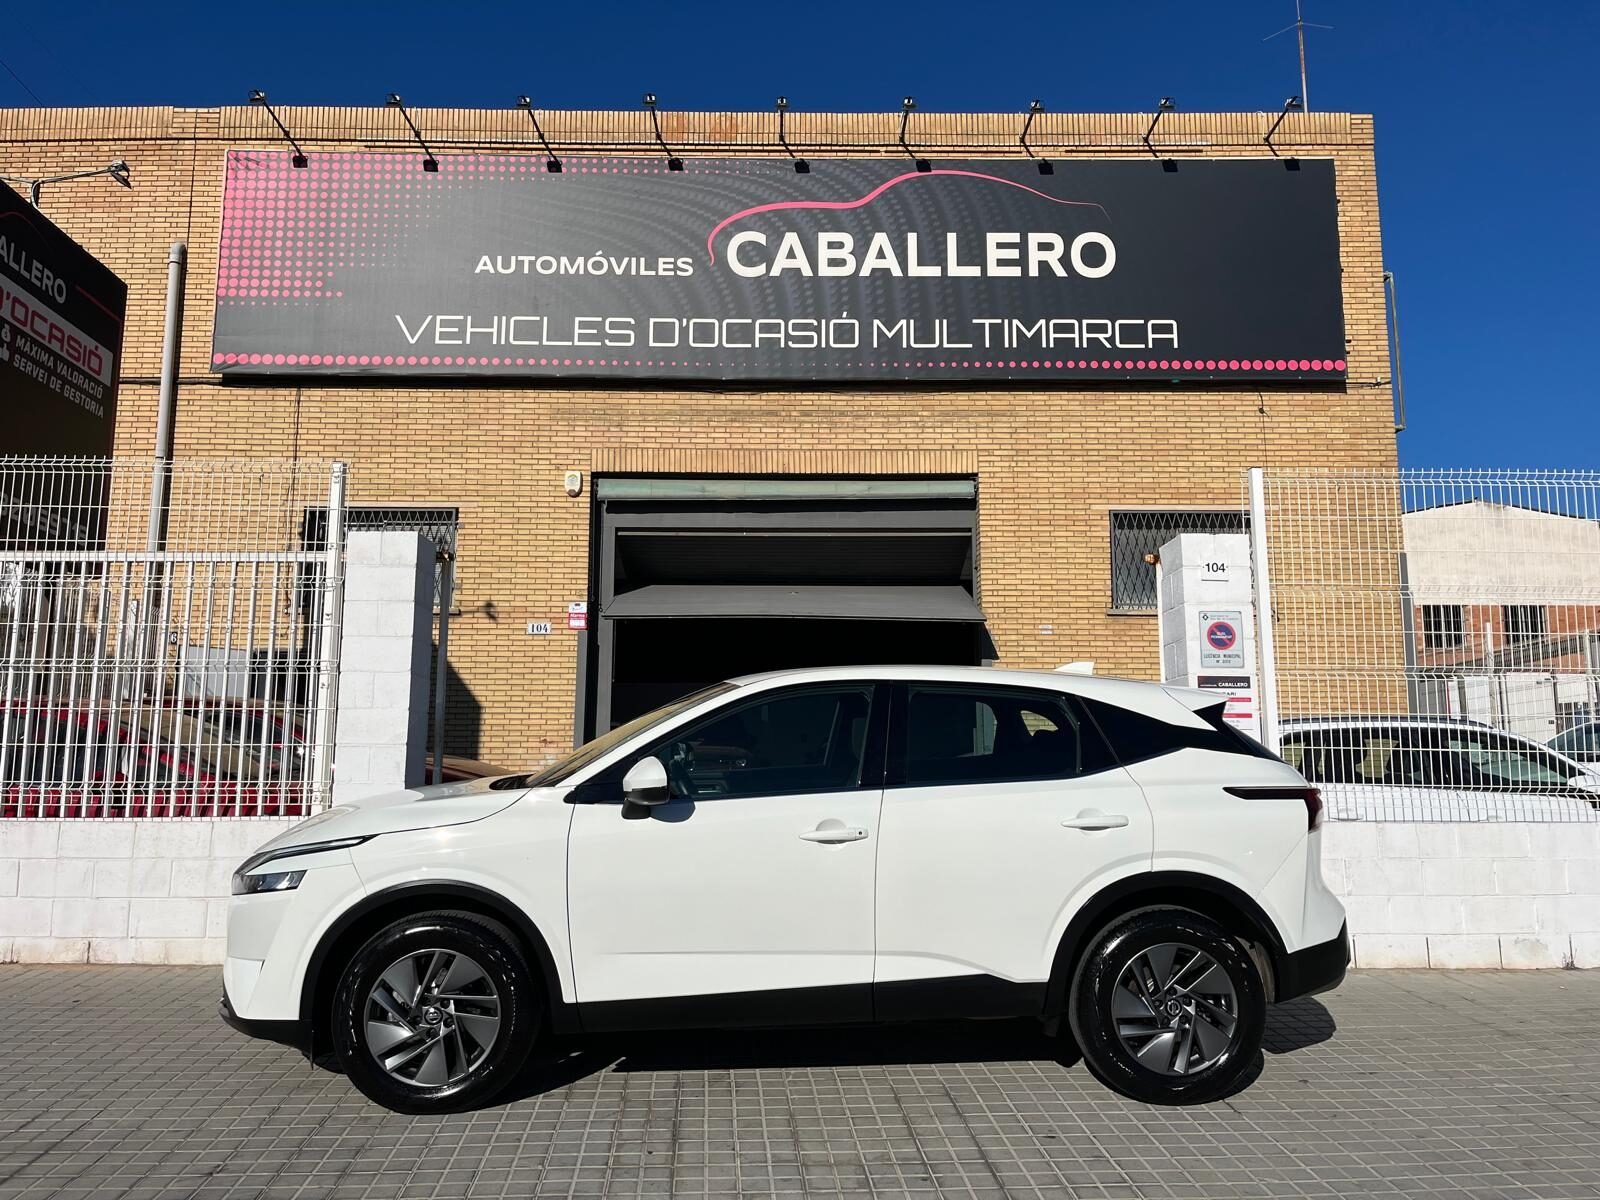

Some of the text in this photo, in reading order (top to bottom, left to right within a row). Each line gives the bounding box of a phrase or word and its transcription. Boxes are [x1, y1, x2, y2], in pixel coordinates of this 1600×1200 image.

[474, 231, 1117, 279] AUTOMÓVILES CABALLERO
[395, 311, 1179, 350] VEHICLES D'OCASIÓ MULTIMARCA
[13, 354, 104, 419] SERVEI DE GESTORIA
[1205, 563, 1226, 573] 104
[531, 623, 548, 633] 104
